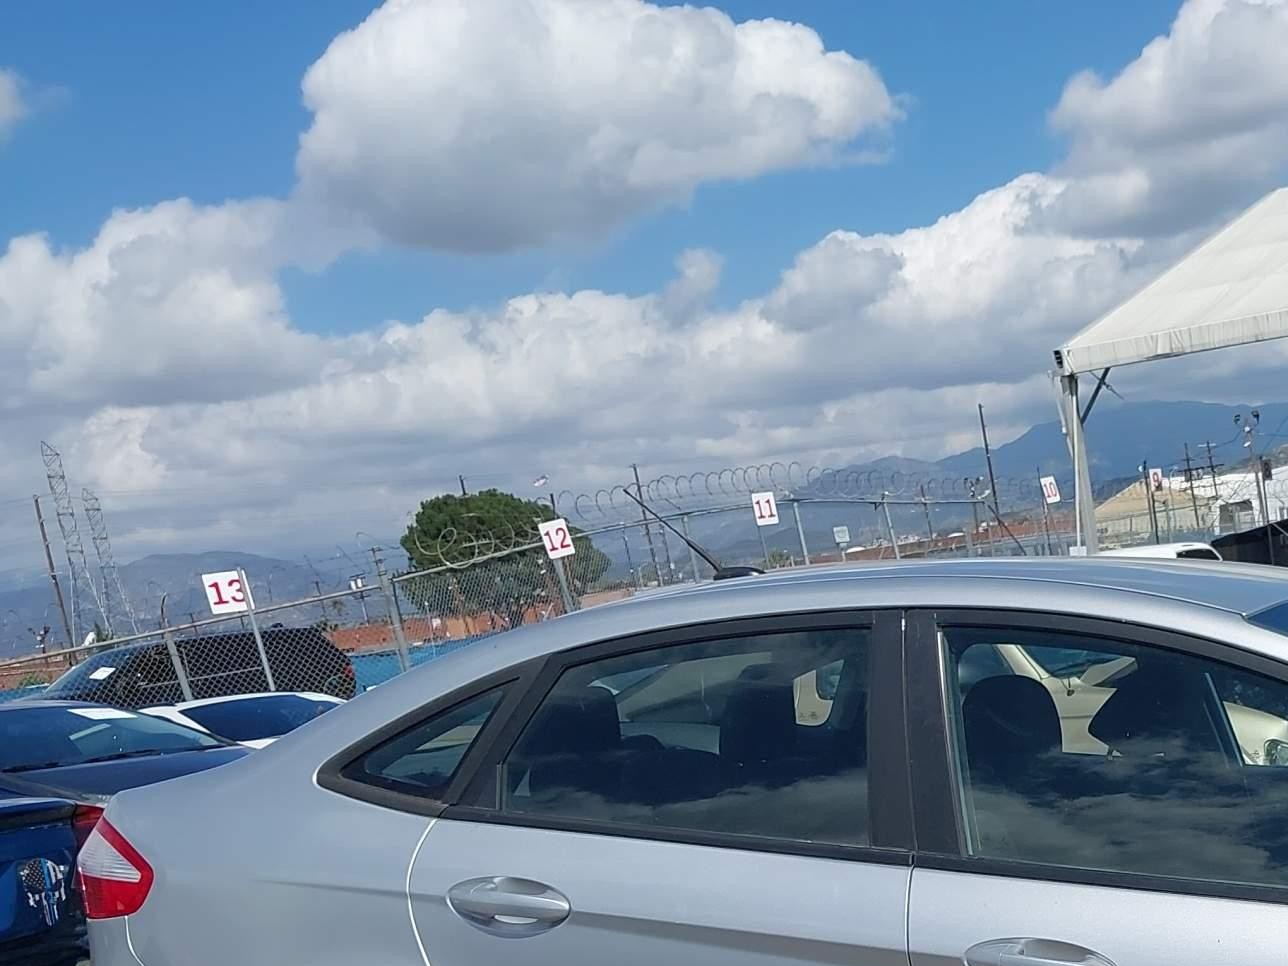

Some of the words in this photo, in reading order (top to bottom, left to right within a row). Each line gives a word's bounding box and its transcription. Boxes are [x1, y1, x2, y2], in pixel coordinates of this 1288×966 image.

[1043, 481, 1057, 498] 10
[1152, 472, 1160, 487] 9
[755, 499, 776, 519] 11
[544, 528, 570, 552] 12
[208, 579, 244, 605] 13
